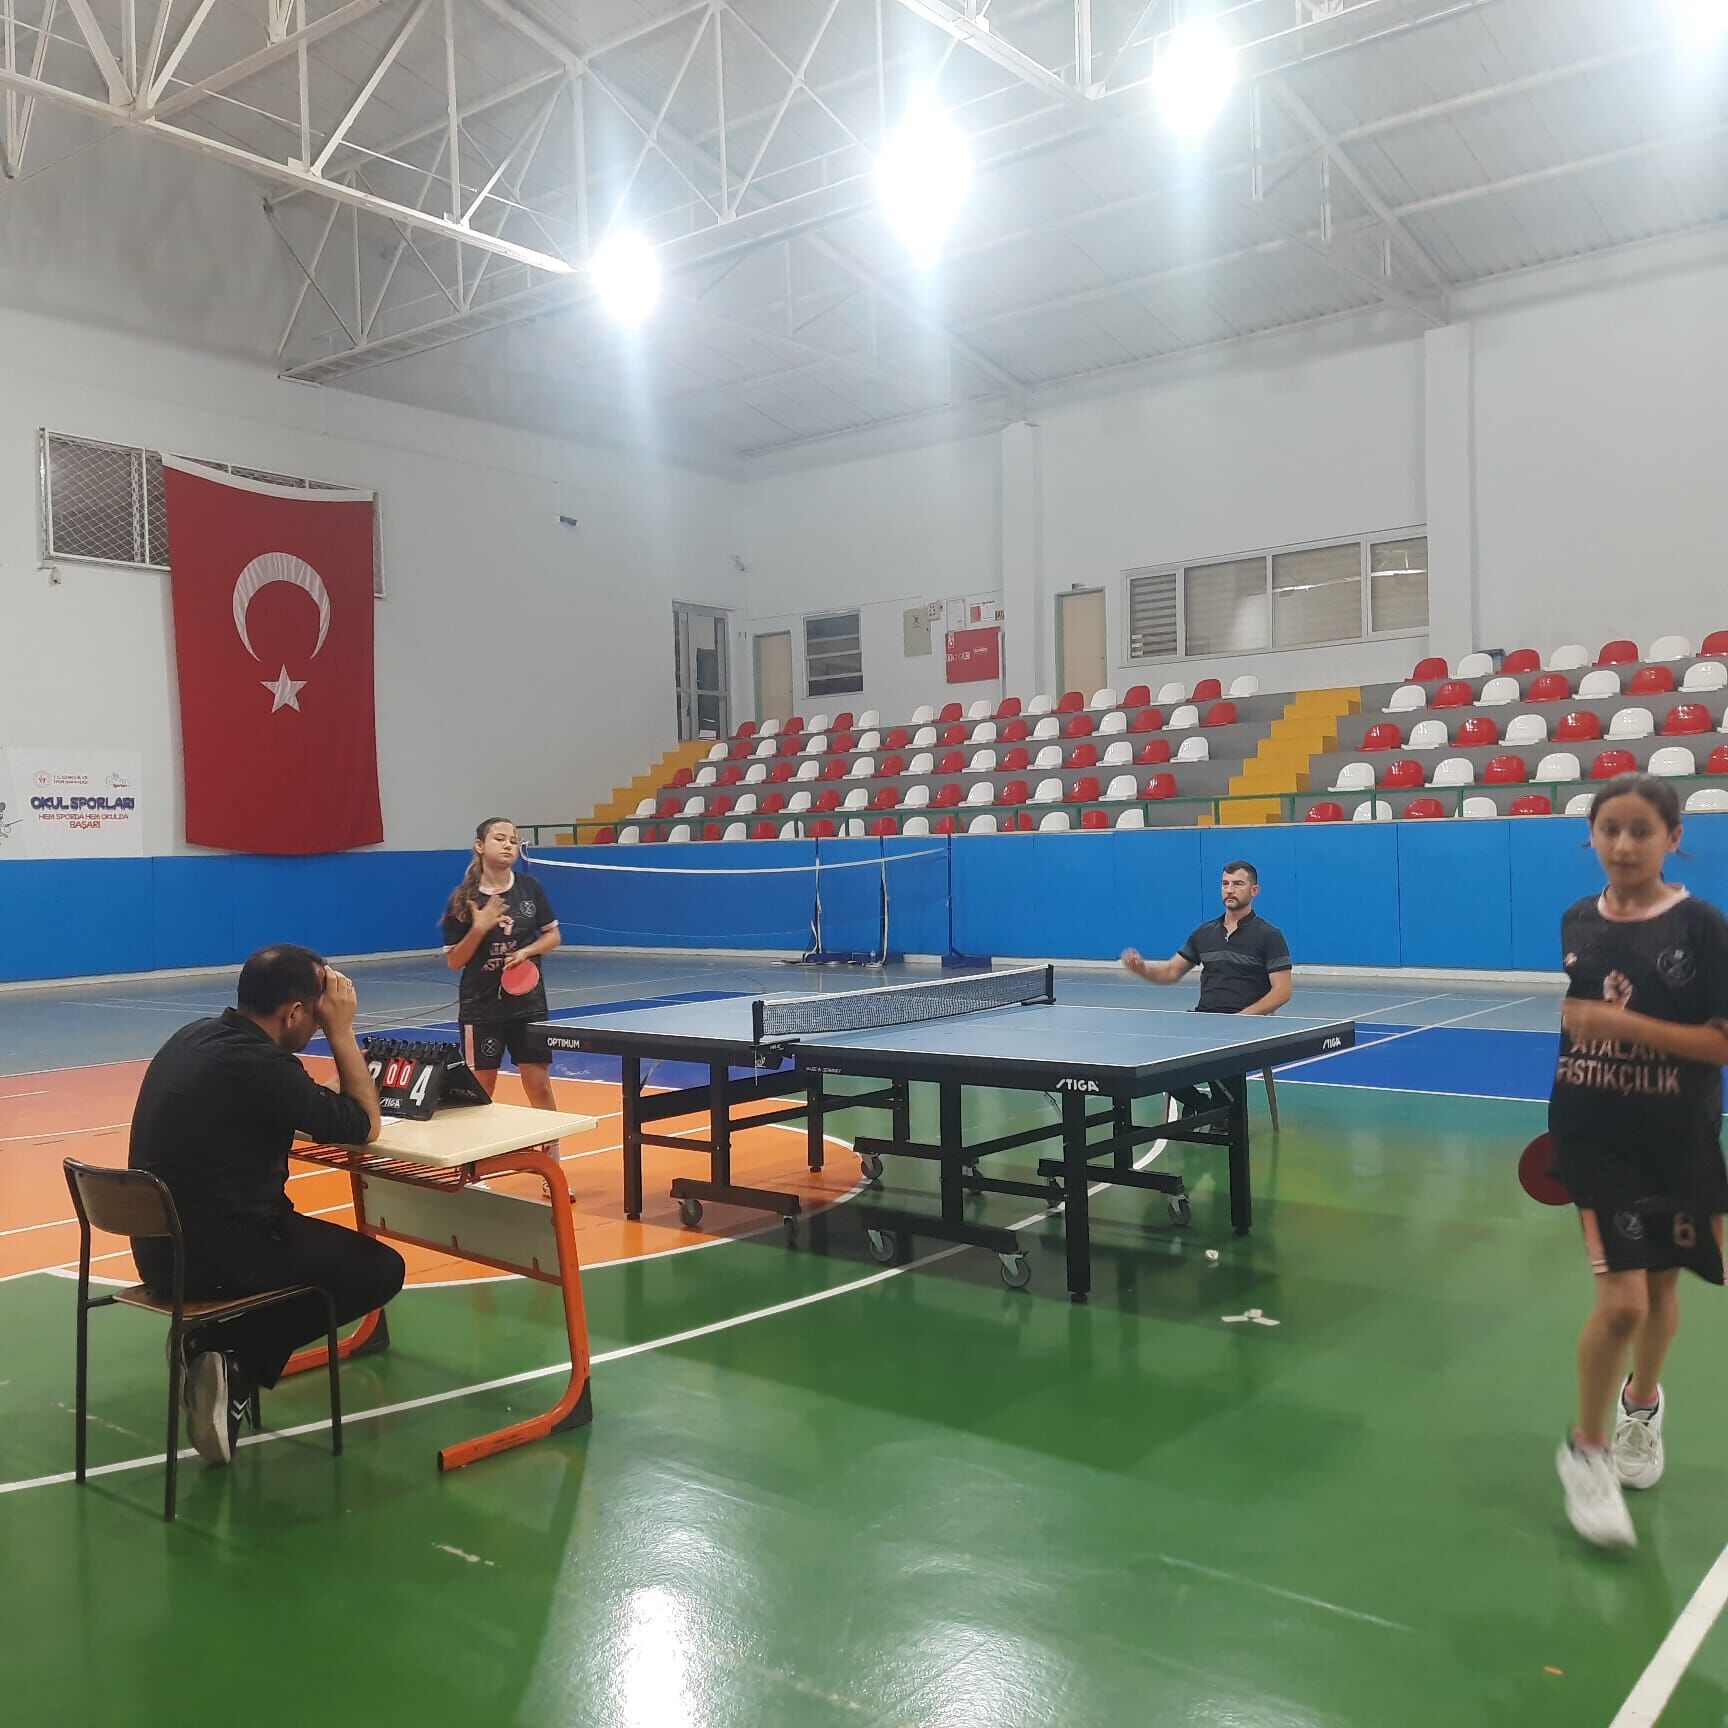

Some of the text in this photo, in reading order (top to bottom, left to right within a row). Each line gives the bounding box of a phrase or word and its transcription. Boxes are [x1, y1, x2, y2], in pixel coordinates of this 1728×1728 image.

[30, 796, 135, 810] OKUL SPORLARI
[69, 821, 101, 829] BAŞARI
[547, 1037, 580, 1049] OPTIMUM
[1323, 1036, 1341, 1049] STIGA
[409, 1064, 434, 1106] 4
[1055, 1078, 1100, 1092] STIGA
[1673, 1211, 1697, 1248] 6
